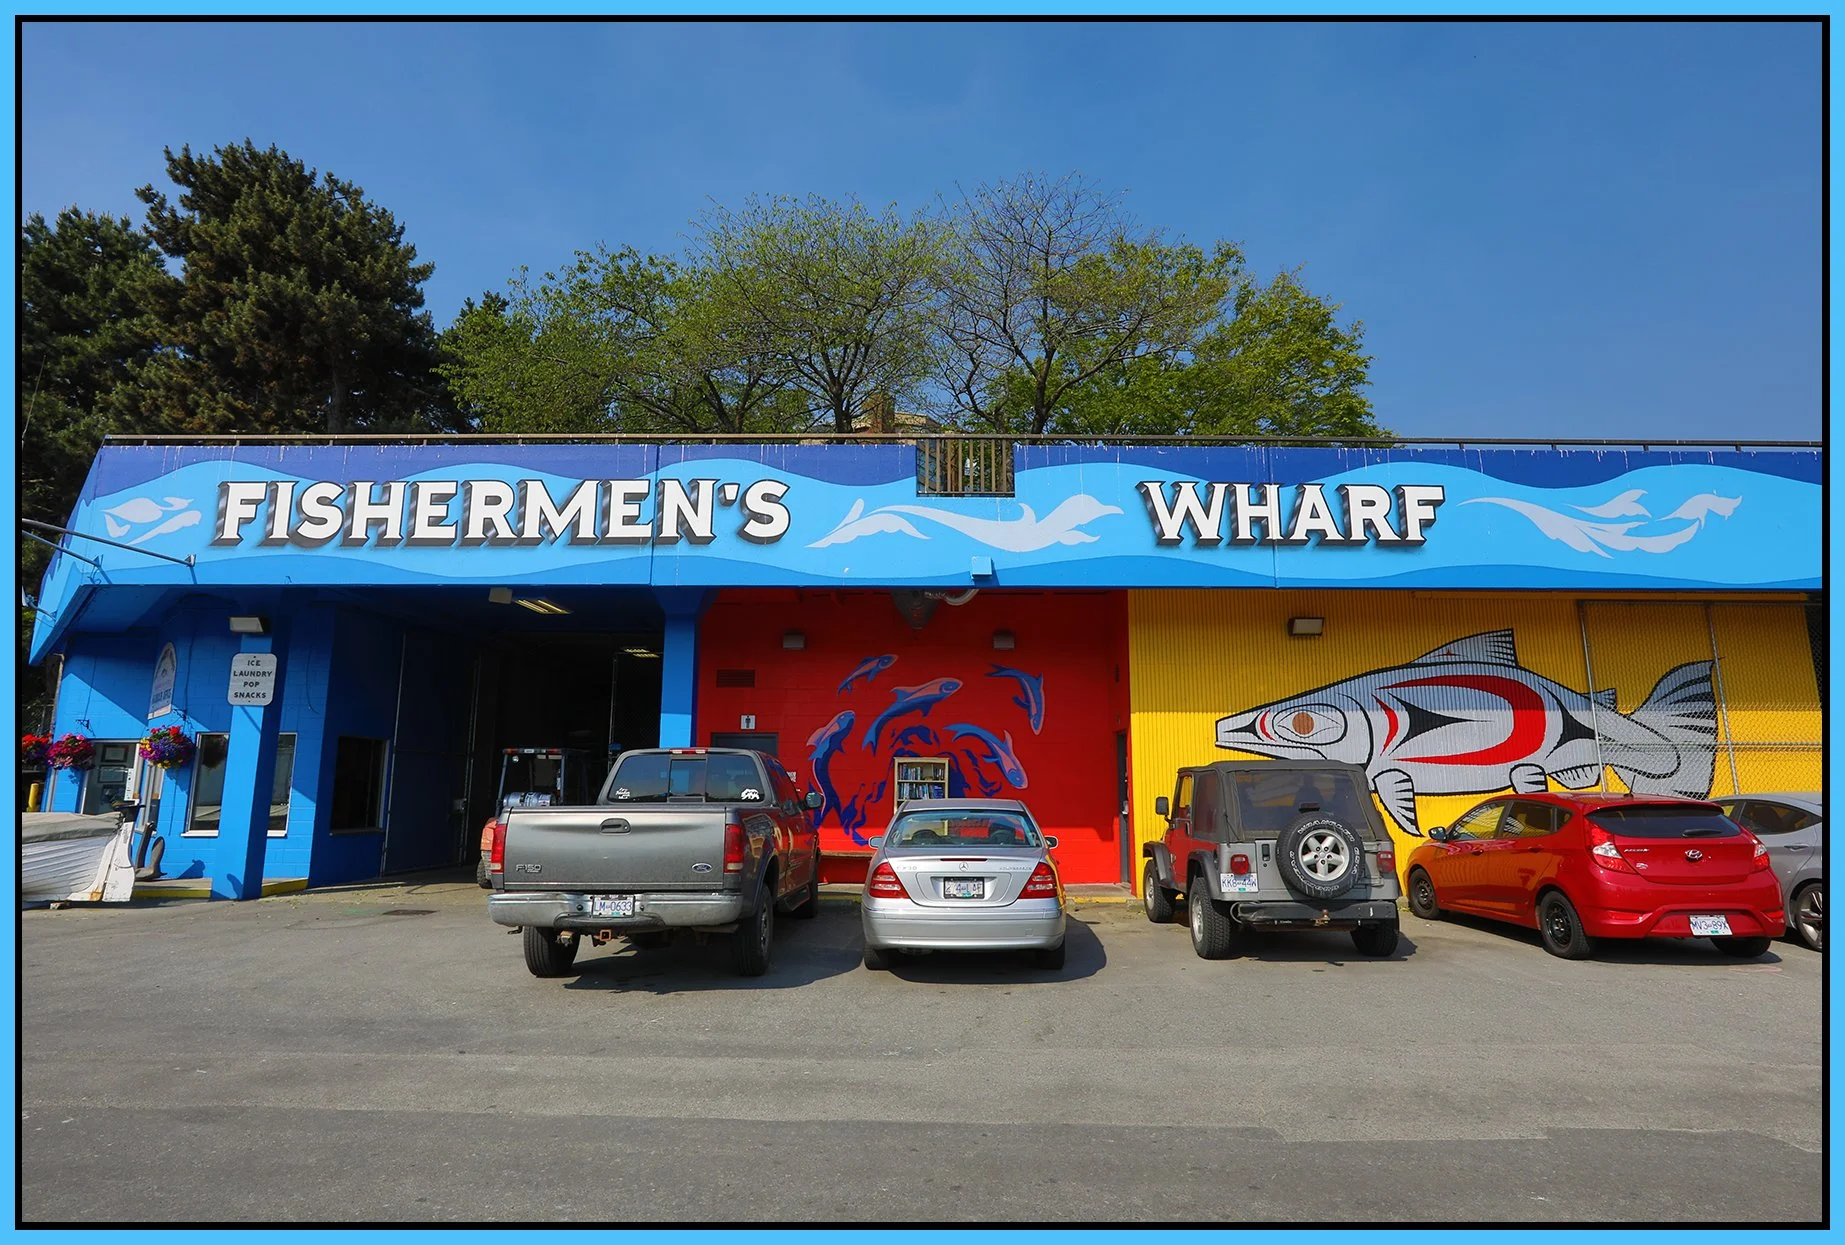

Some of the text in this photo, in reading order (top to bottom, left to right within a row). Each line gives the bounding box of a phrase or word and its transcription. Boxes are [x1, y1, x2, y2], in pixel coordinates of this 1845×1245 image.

[213, 479, 1446, 546] FISHERMEN'S WHARF
[233, 670, 273, 678] LAUNDRY
